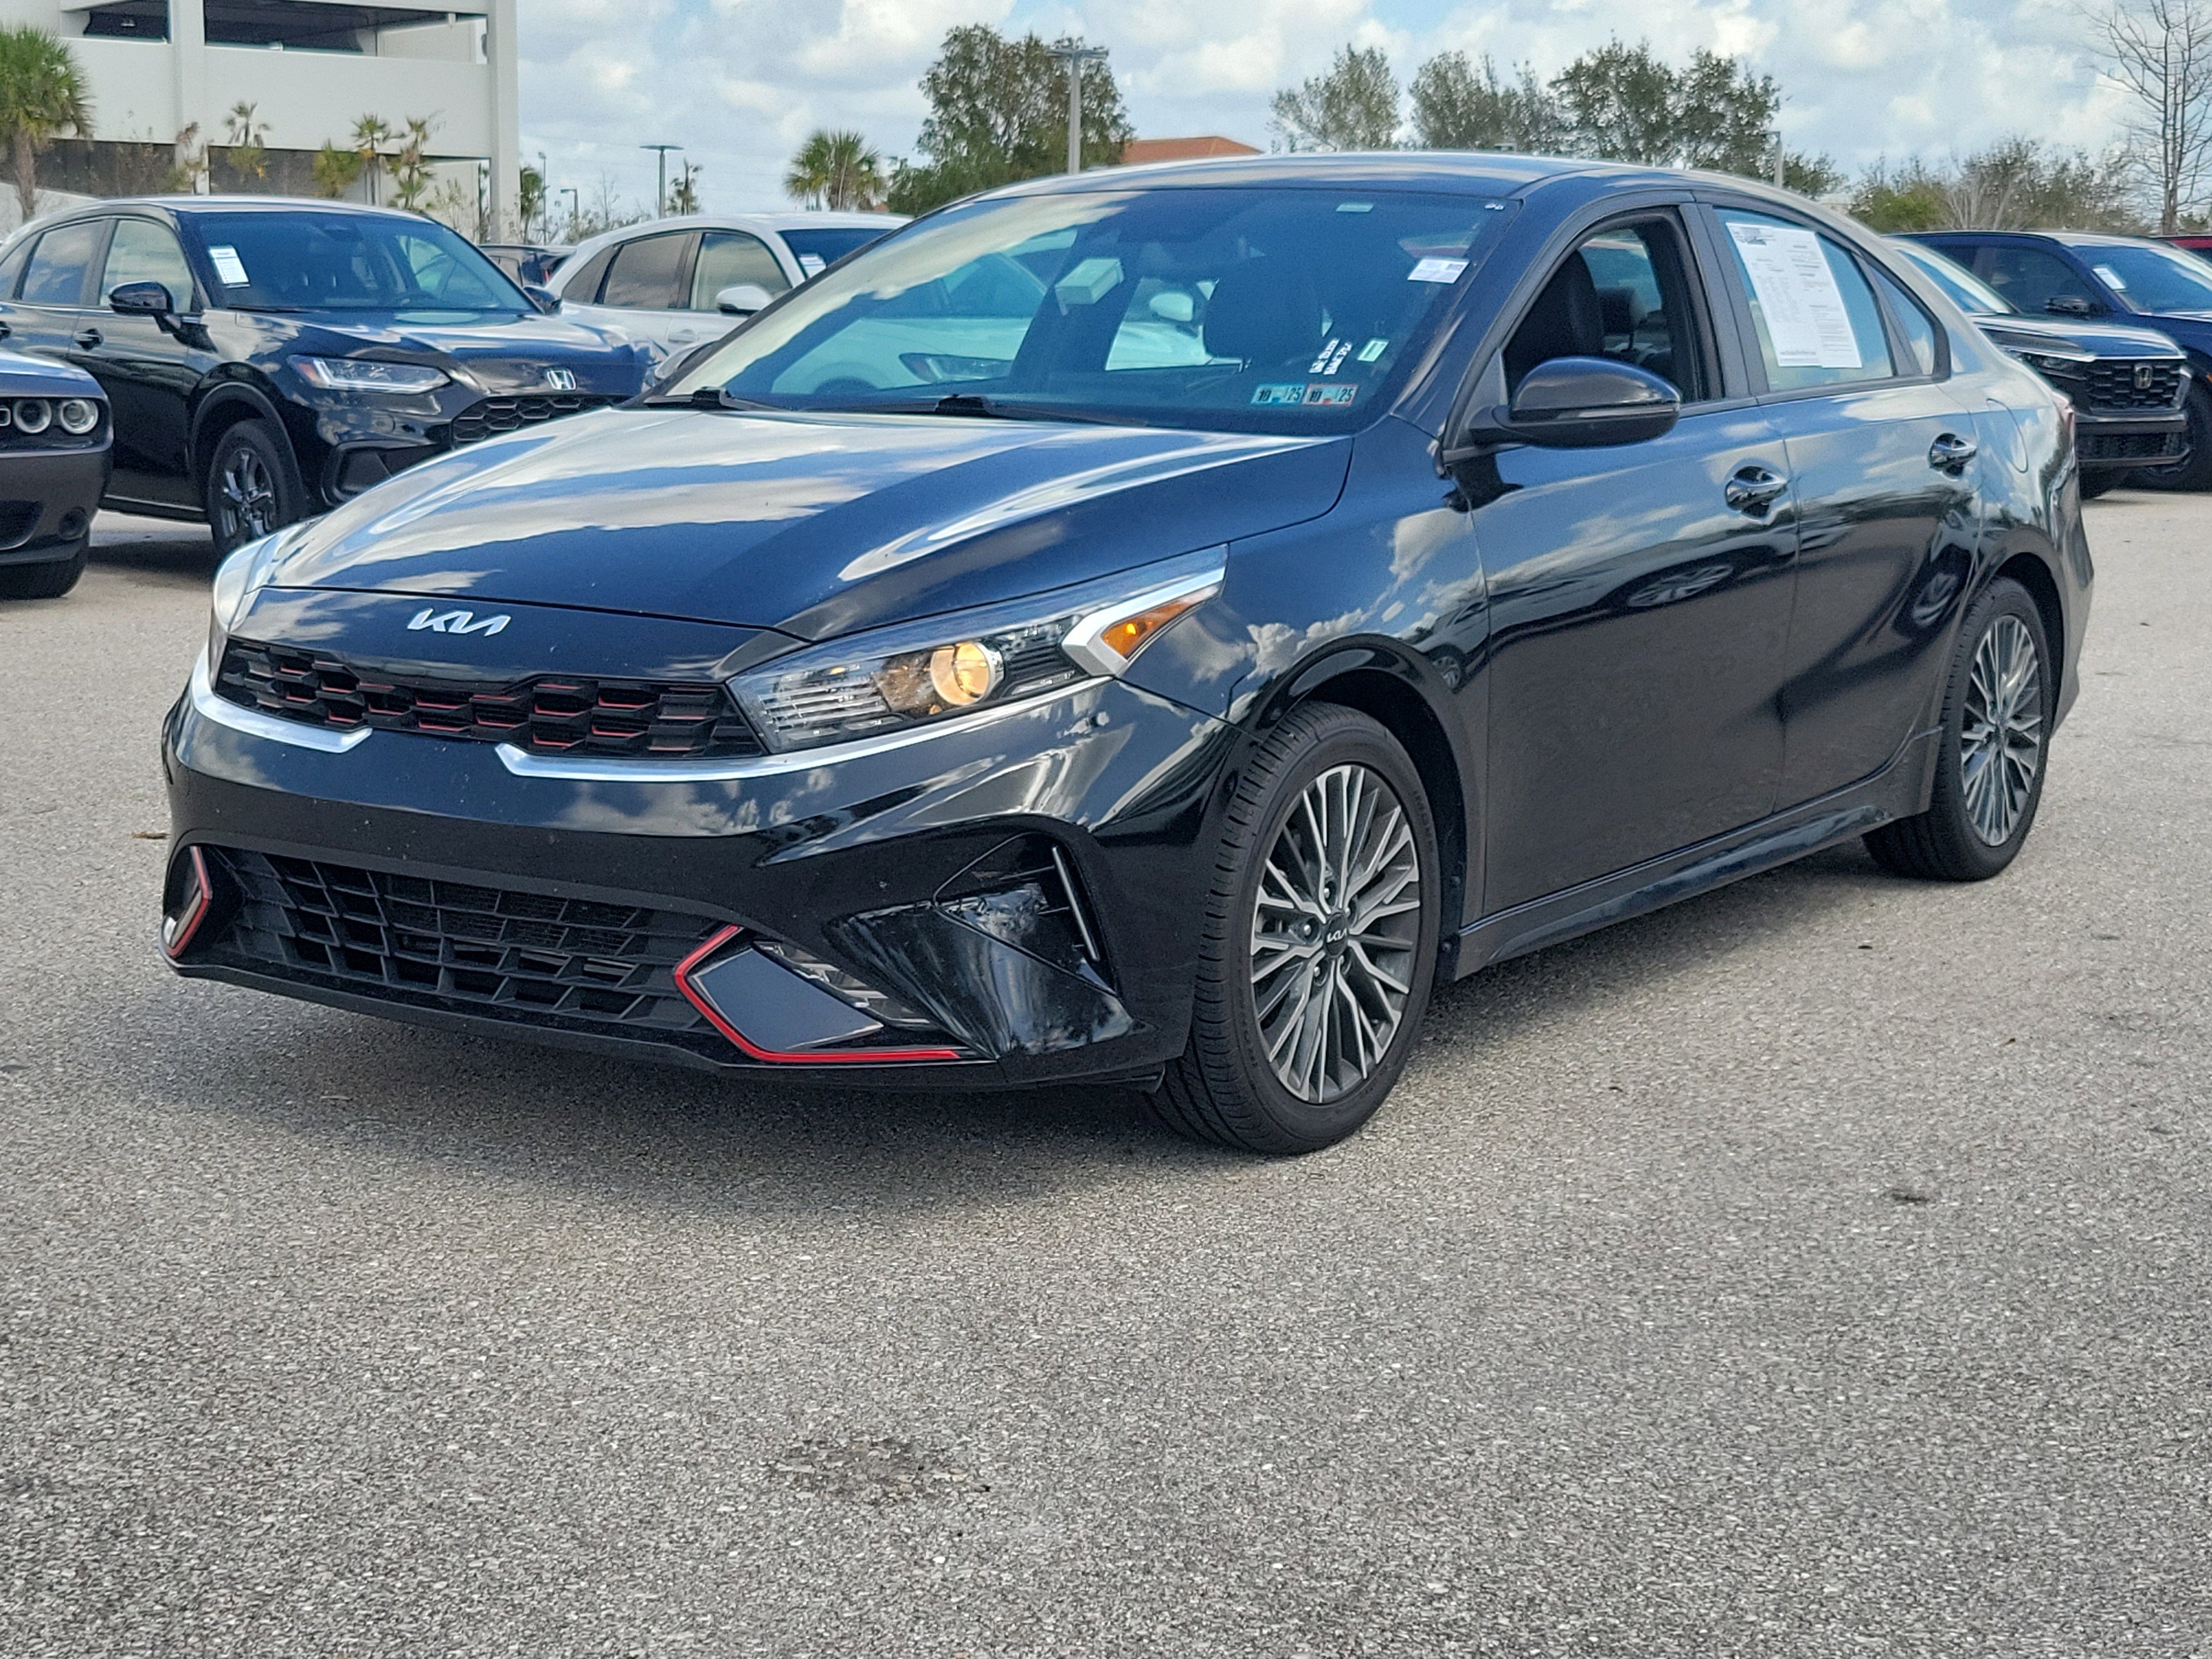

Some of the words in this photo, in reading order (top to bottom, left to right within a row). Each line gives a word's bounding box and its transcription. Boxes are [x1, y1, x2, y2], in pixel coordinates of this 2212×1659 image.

[1259, 388, 1272, 401] 10
[1287, 387, 1302, 401] 25
[1339, 387, 1353, 402] 25
[407, 608, 511, 636] KIA
